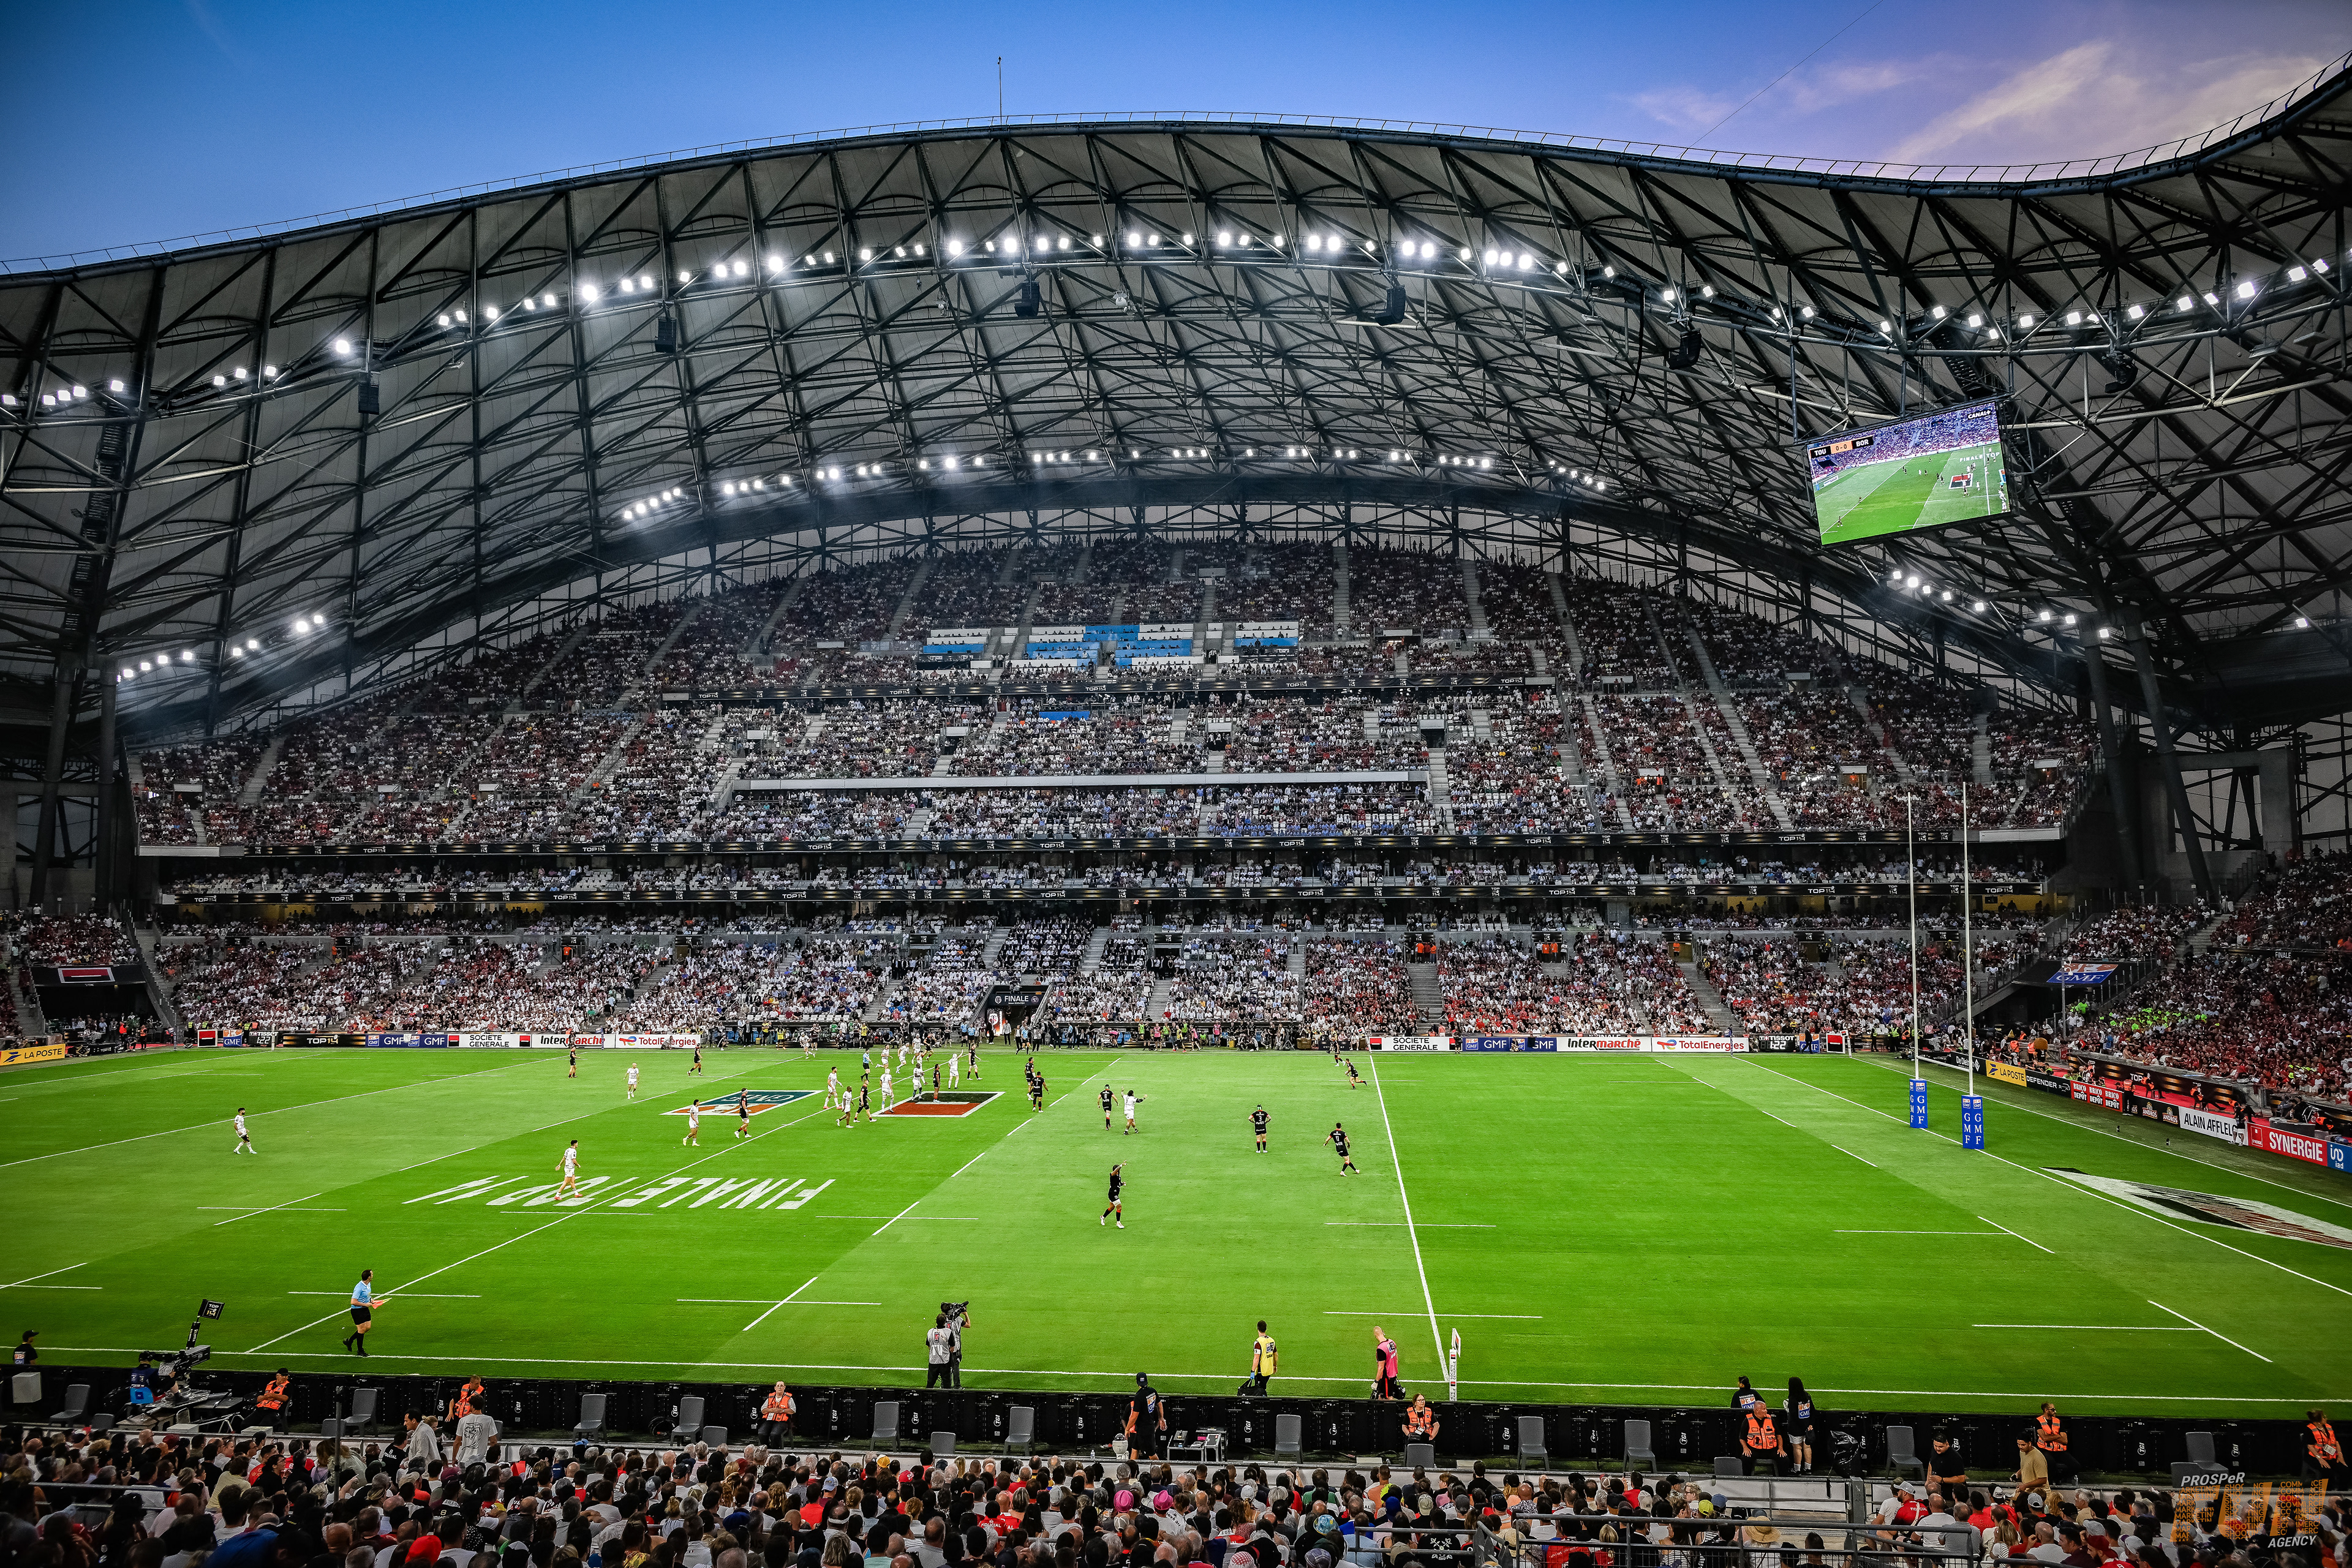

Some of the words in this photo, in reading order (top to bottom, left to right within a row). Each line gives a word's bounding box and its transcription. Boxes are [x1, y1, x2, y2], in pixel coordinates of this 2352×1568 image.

[1967, 410, 1991, 420] CANAL+
[540, 1035, 606, 1046] Interarch
[639, 1037, 696, 1047] TotalEergies
[1679, 1041, 1744, 1051] TotalEnerges
[36, 1048, 62, 1058] POSTE
[2000, 1068, 2007, 1077] LA
[2008, 1071, 2025, 1082] POSTE
[2026, 1075, 2057, 1088] DEFENDER
[2073, 1083, 2086, 1092] BRICO
[2089, 1087, 2102, 1096] BRICO
[2105, 1091, 2119, 1099] BRICO
[2143, 1109, 2157, 1118] ANDROS
[2163, 1114, 2178, 1123] ANDROS
[2184, 1113, 2205, 1129] ALAIN
[2269, 1131, 2323, 1162] SYNERGIE
[608, 1177, 837, 1210] FINALE
